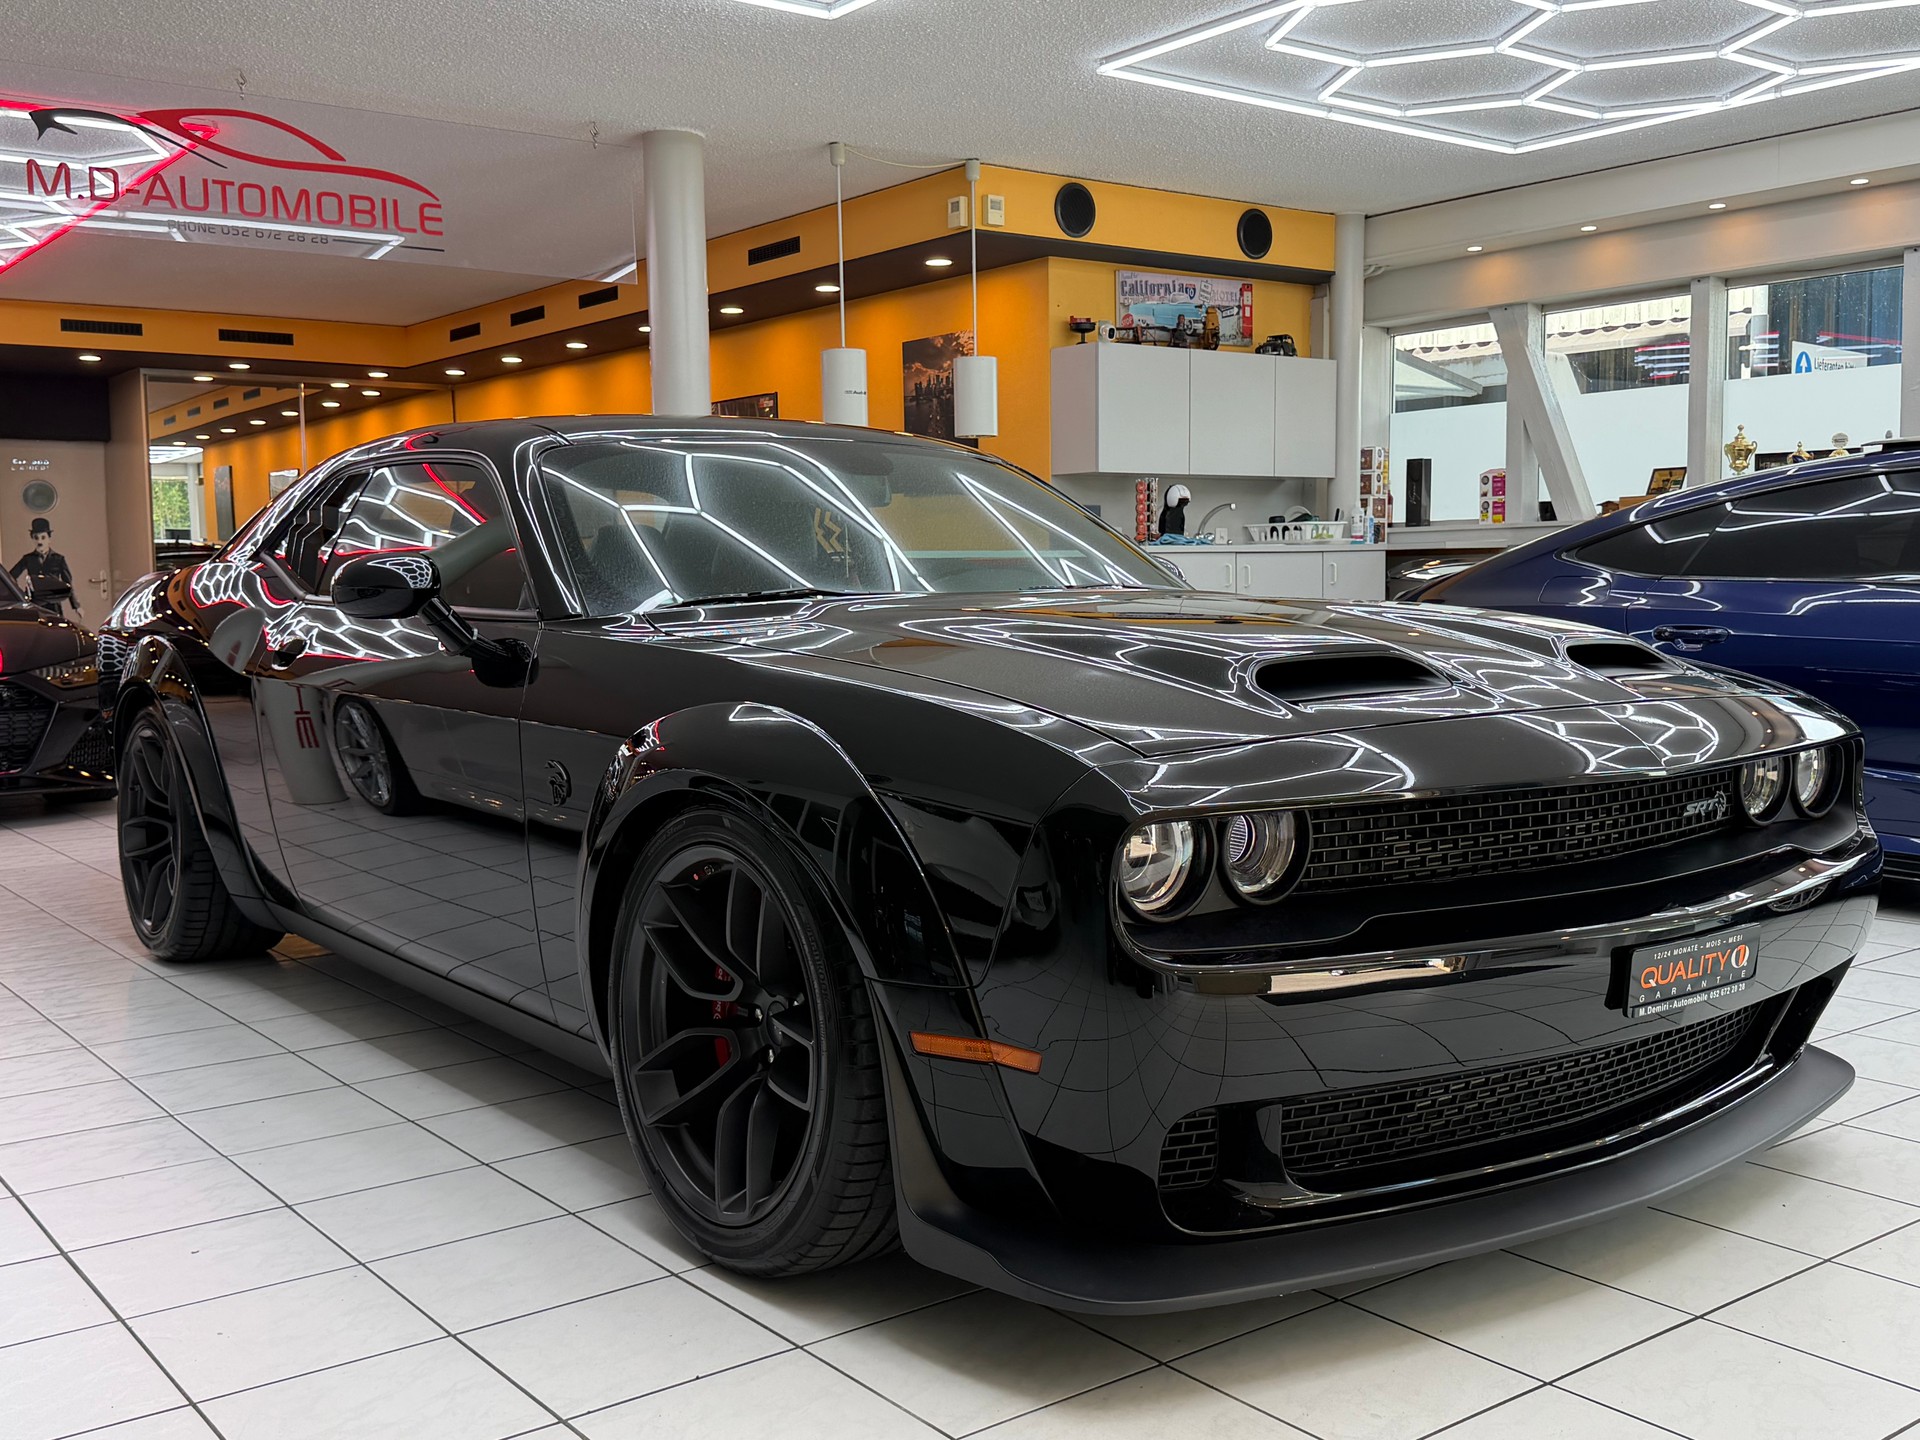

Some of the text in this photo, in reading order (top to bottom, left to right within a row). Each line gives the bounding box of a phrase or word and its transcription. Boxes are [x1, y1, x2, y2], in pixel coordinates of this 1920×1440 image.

[1121, 280, 1184, 297] California
[1683, 798, 1719, 817] SRT
[1653, 950, 1671, 960] 12/24
[1673, 944, 1699, 956] MONATE
[1706, 939, 1721, 948] MOIS
[1728, 934, 1743, 943] MESI
[1639, 969, 1746, 1003] GARANTIE
